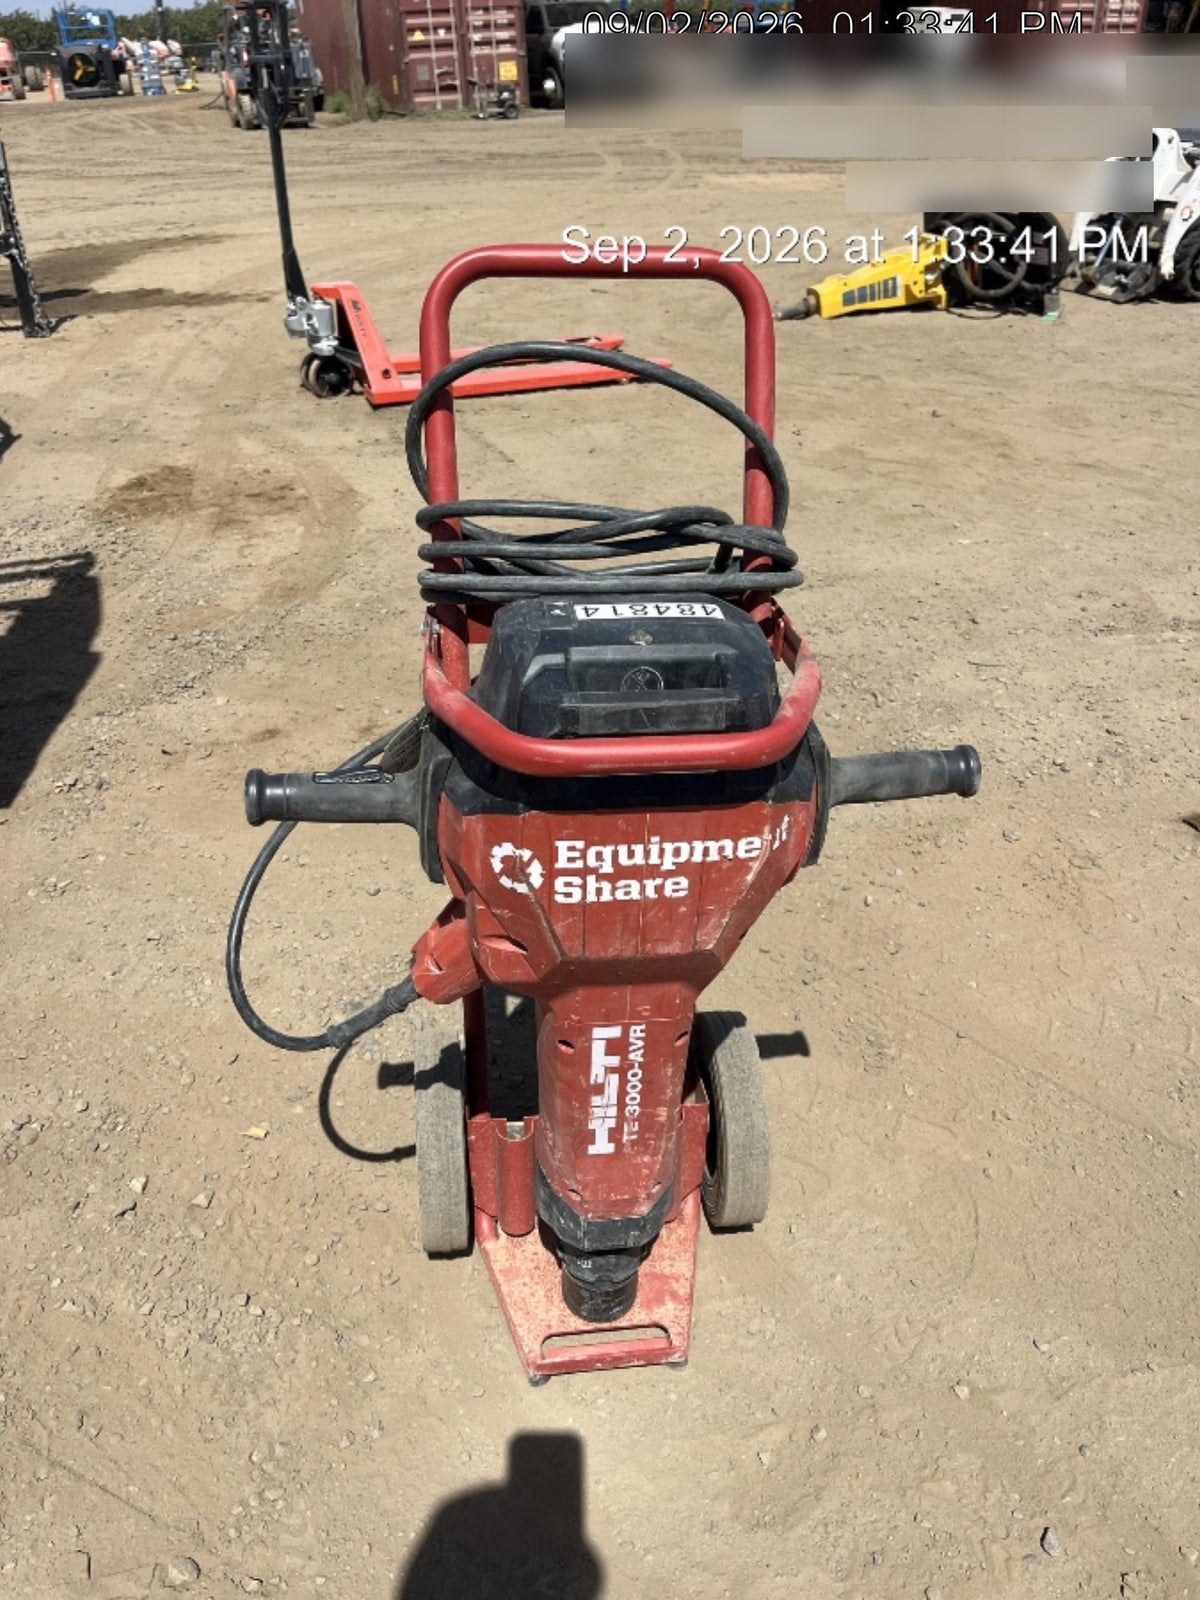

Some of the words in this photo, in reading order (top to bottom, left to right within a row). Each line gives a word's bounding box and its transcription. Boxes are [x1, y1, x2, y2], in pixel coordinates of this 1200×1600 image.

[554, 874, 689, 904] Share
[587, 1025, 623, 1155] HILTI
[625, 1024, 647, 1118] 3000-AVR
